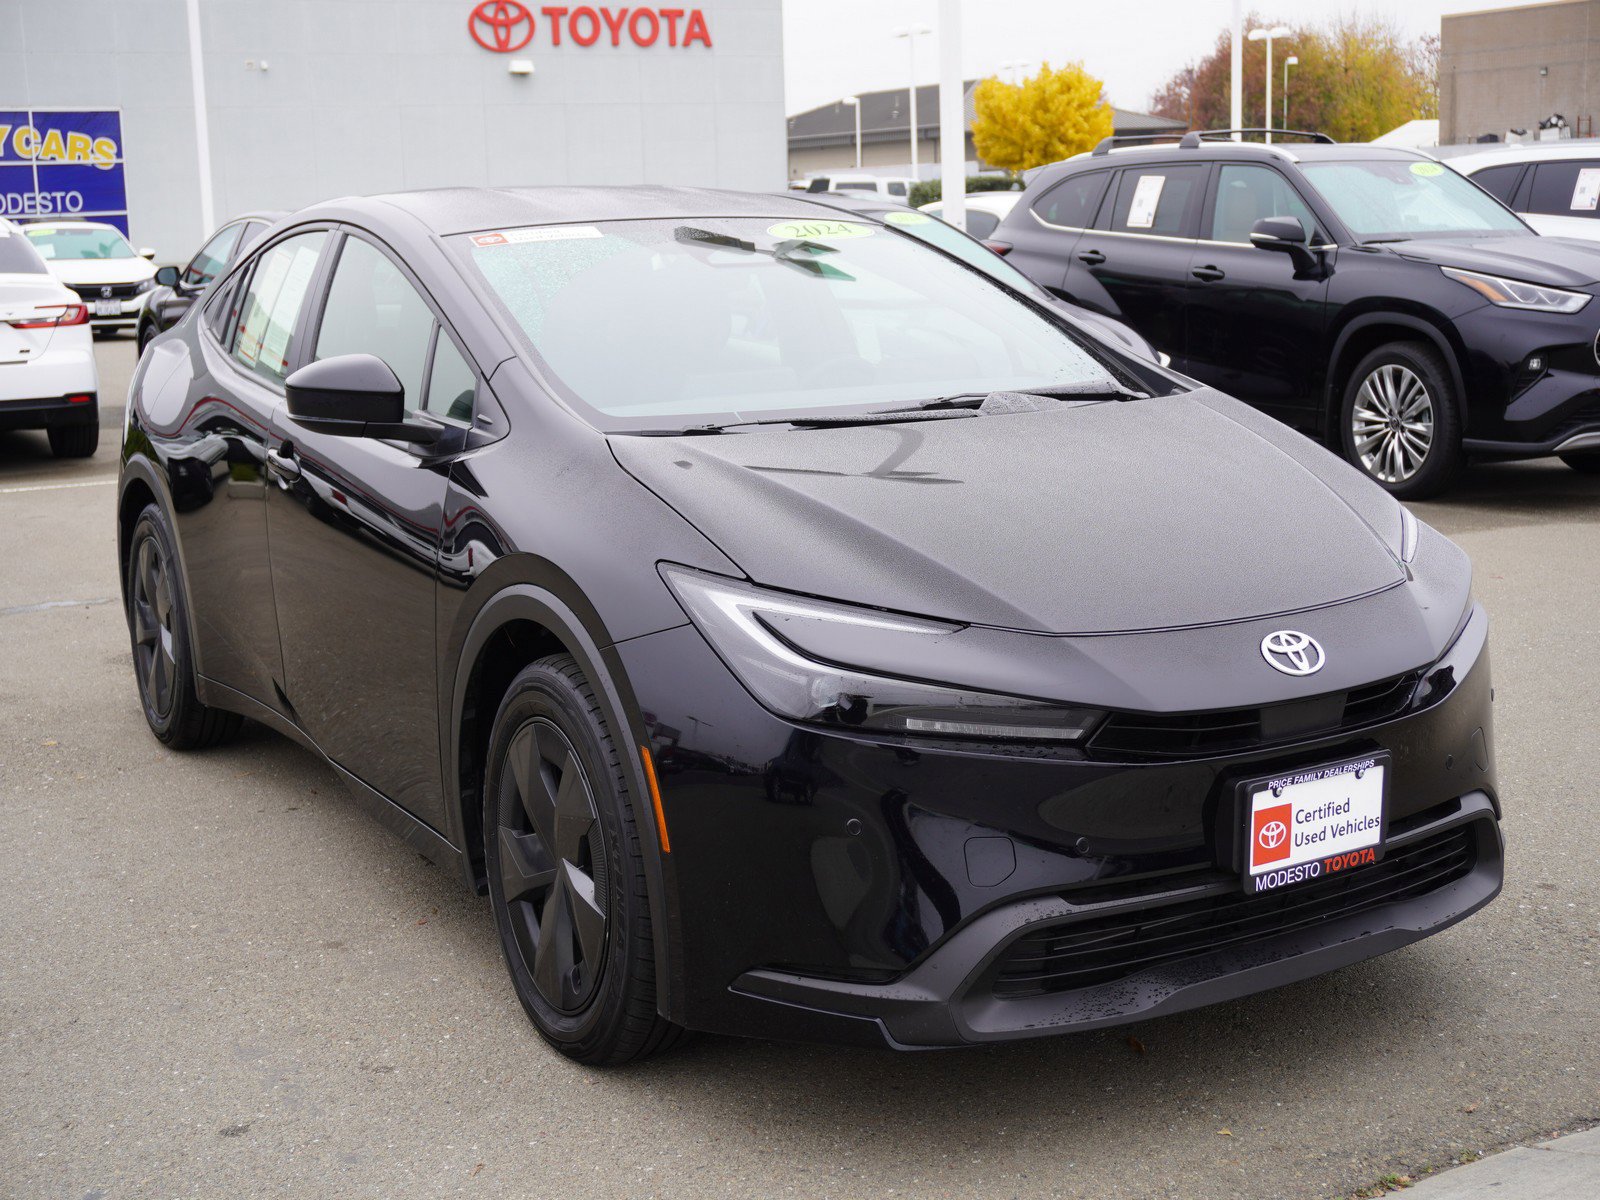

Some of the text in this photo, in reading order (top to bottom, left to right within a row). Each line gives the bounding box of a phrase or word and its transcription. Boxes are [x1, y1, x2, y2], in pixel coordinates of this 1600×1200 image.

[541, 6, 712, 48] TOYOTA
[13, 124, 118, 170] CARS
[784, 223, 853, 238] 2024
[1267, 759, 1375, 790] PRICE FAMILY DEALERSHIPS
[1295, 797, 1350, 824] Certified
[1294, 815, 1380, 848] Used Vehicles
[1255, 847, 1376, 892] MODESTO TOYOTA
